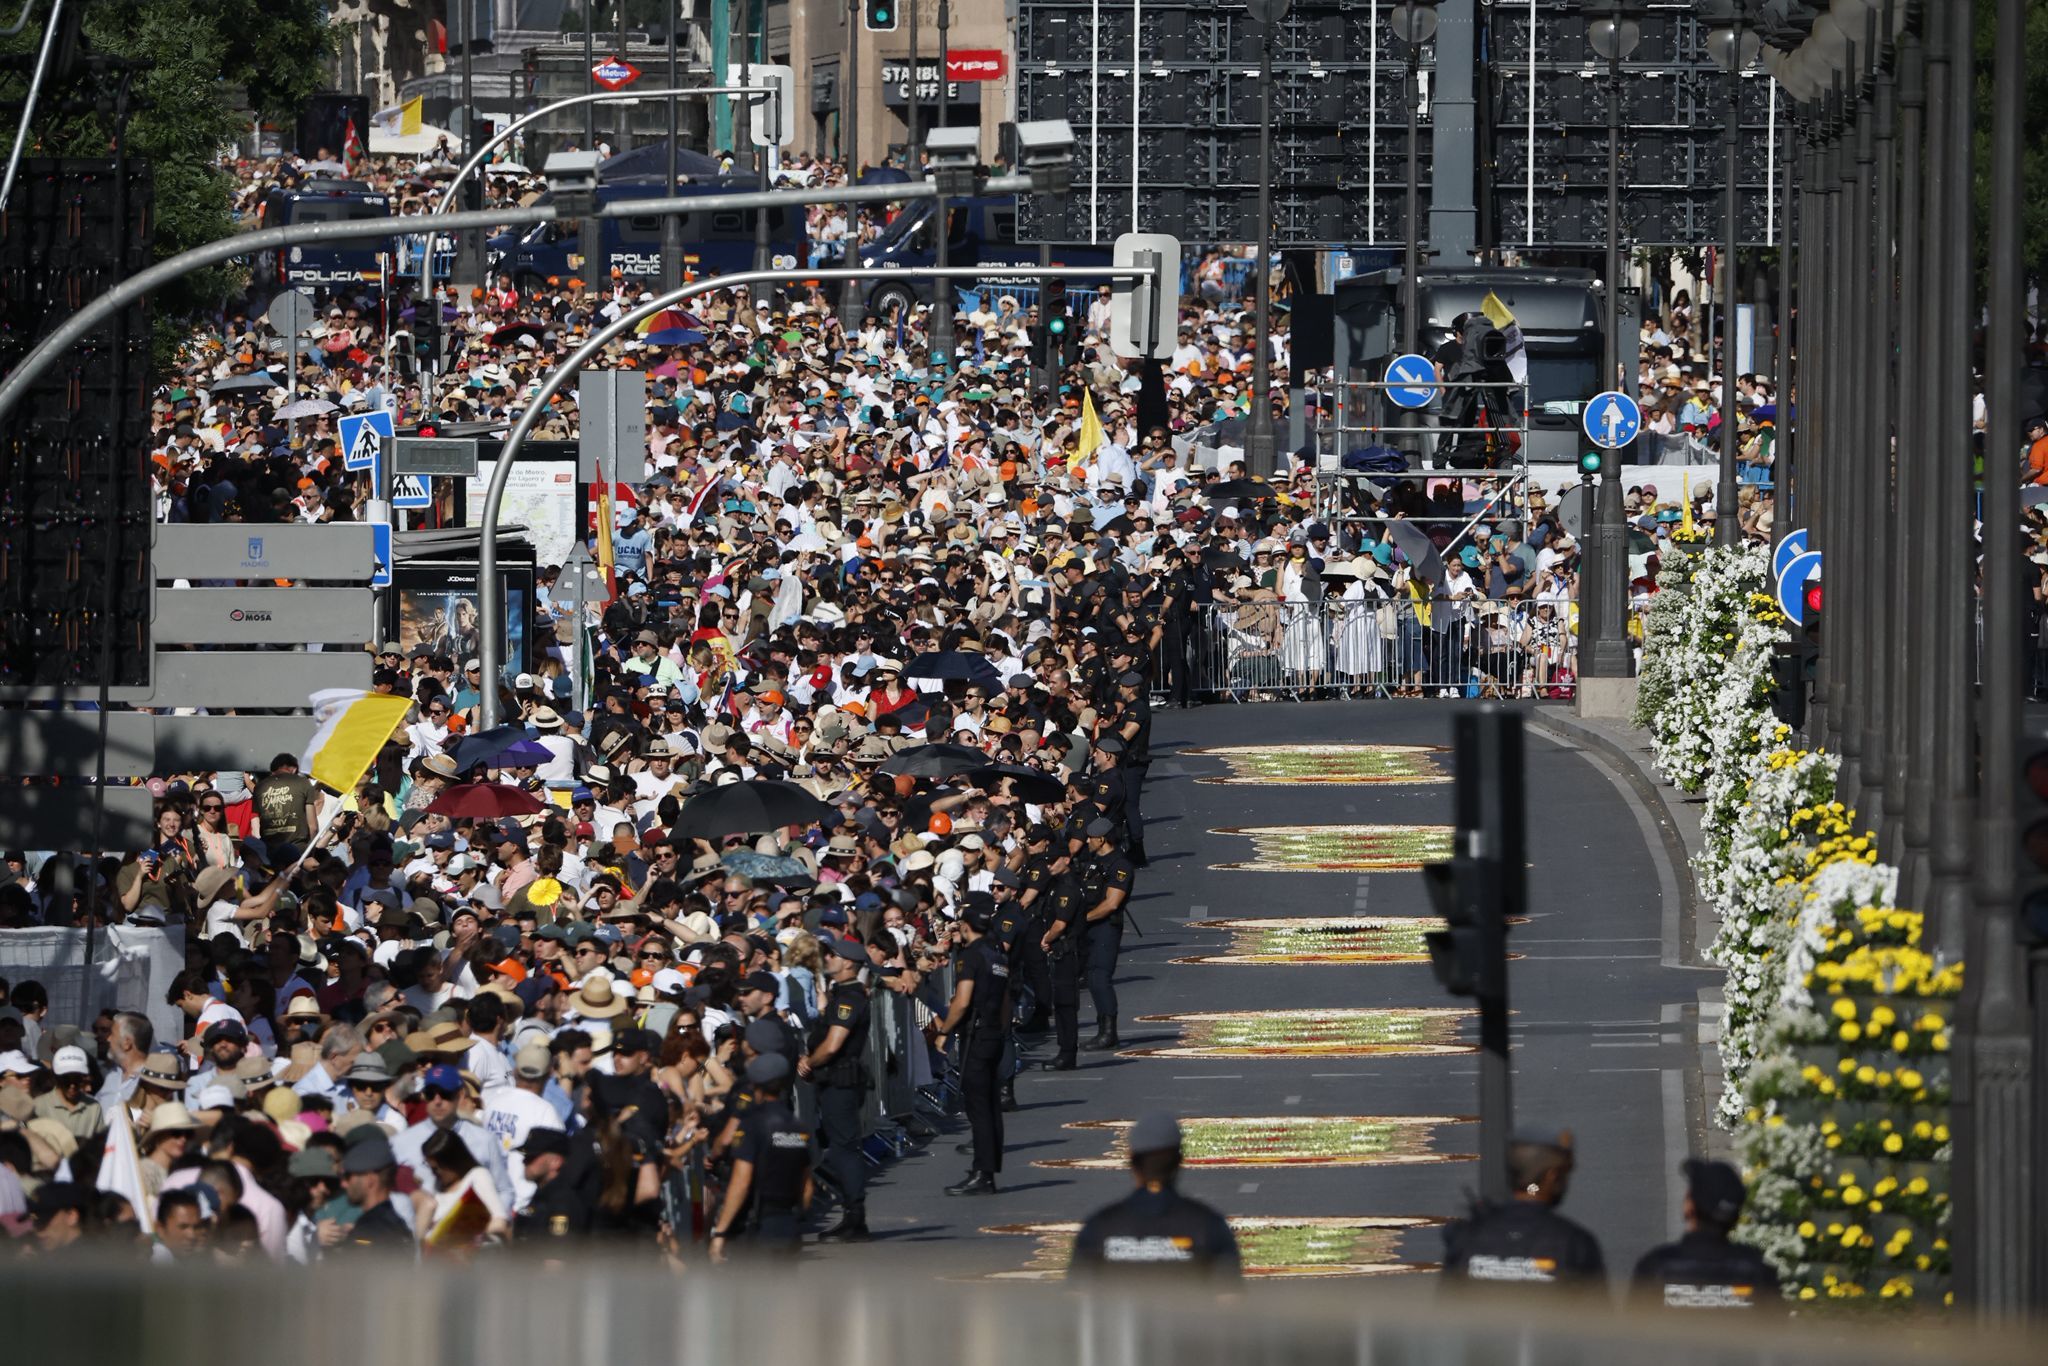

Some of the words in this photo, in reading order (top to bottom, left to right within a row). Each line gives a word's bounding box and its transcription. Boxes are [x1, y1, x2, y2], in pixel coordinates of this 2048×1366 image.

[947, 61, 999, 71] VIPS
[600, 69, 627, 78] Metro
[899, 83, 957, 98] CFFE
[288, 270, 364, 281] POLICIA
